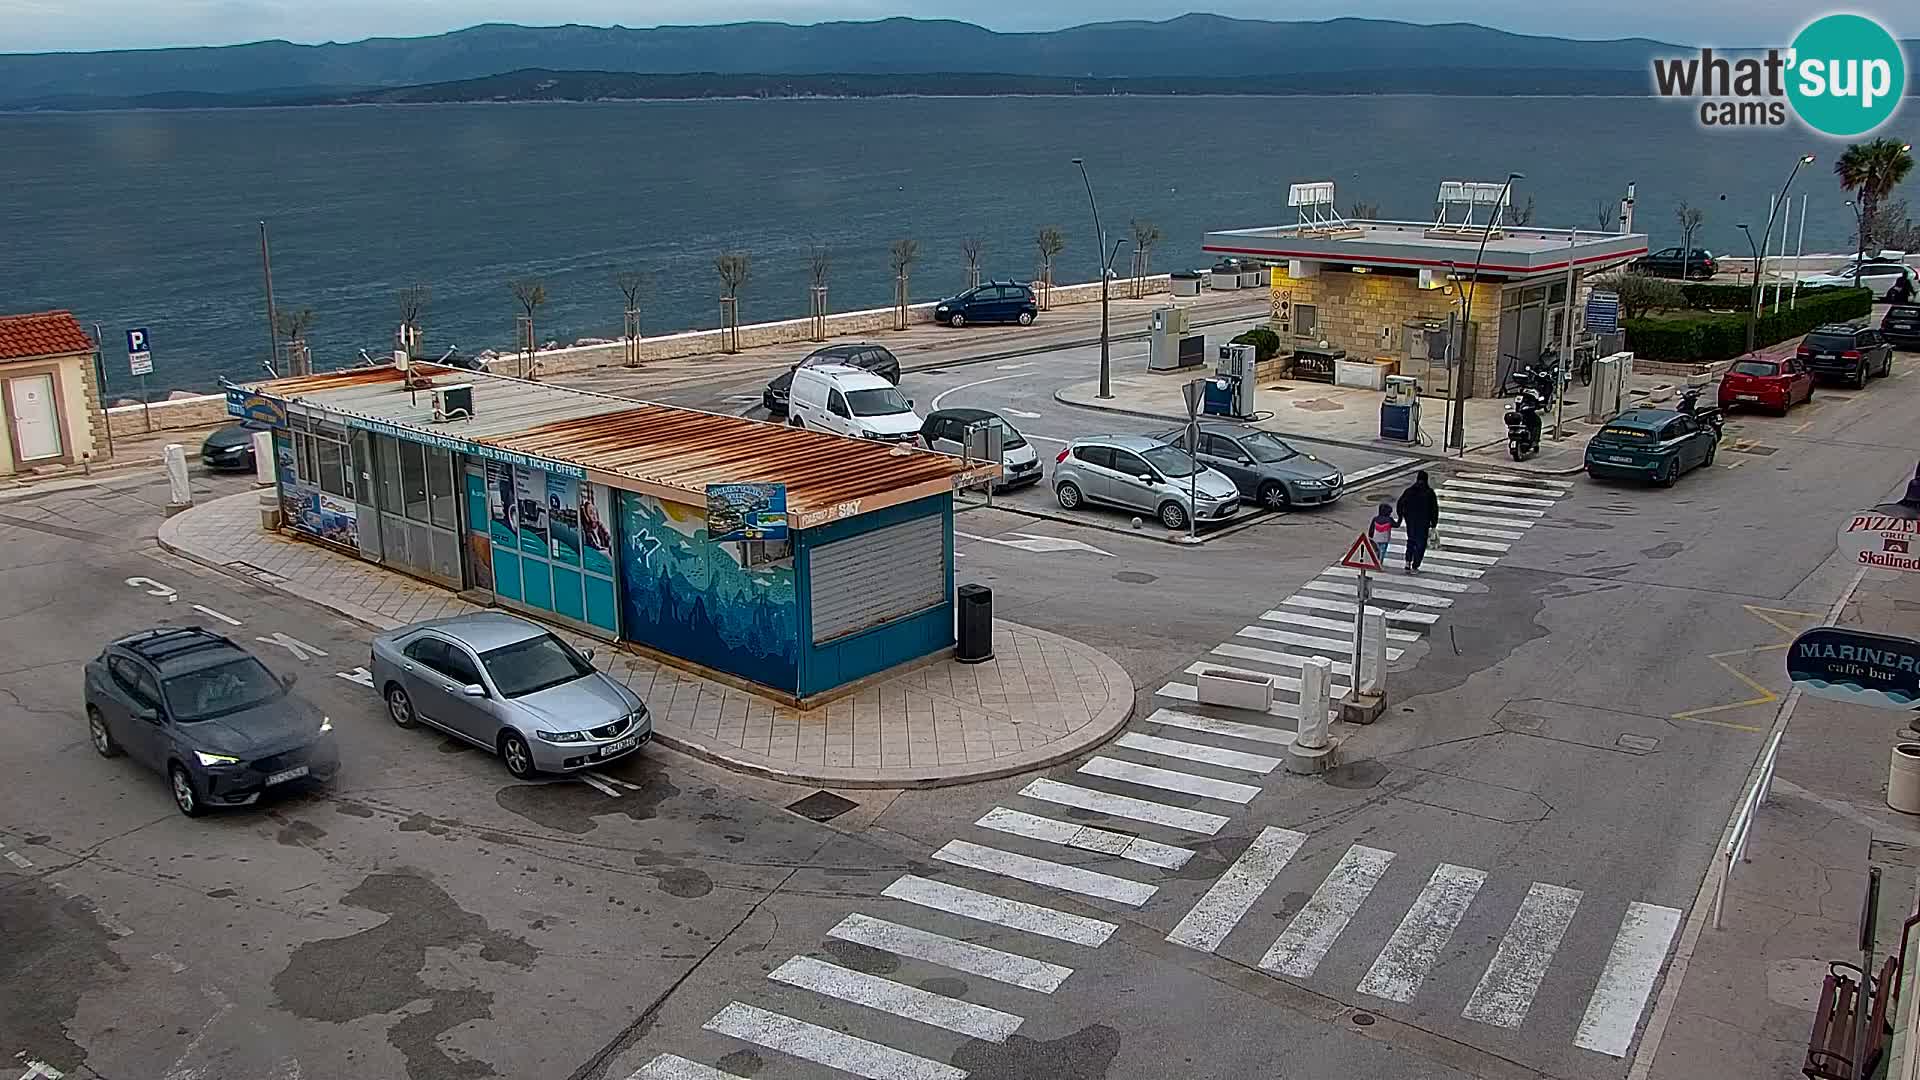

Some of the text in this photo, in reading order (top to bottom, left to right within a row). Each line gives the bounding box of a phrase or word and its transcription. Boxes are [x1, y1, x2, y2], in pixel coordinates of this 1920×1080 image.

[131, 331, 144, 350] P
[437, 436, 469, 452] POSTAJA
[478, 447, 493, 458] BUS
[494, 450, 527, 465] STATION
[528, 457, 555, 471] TICKET
[556, 463, 583, 478] OFFICE
[1880, 531, 1916, 541] GRILL
[1827, 663, 1896, 681] caffe bar
